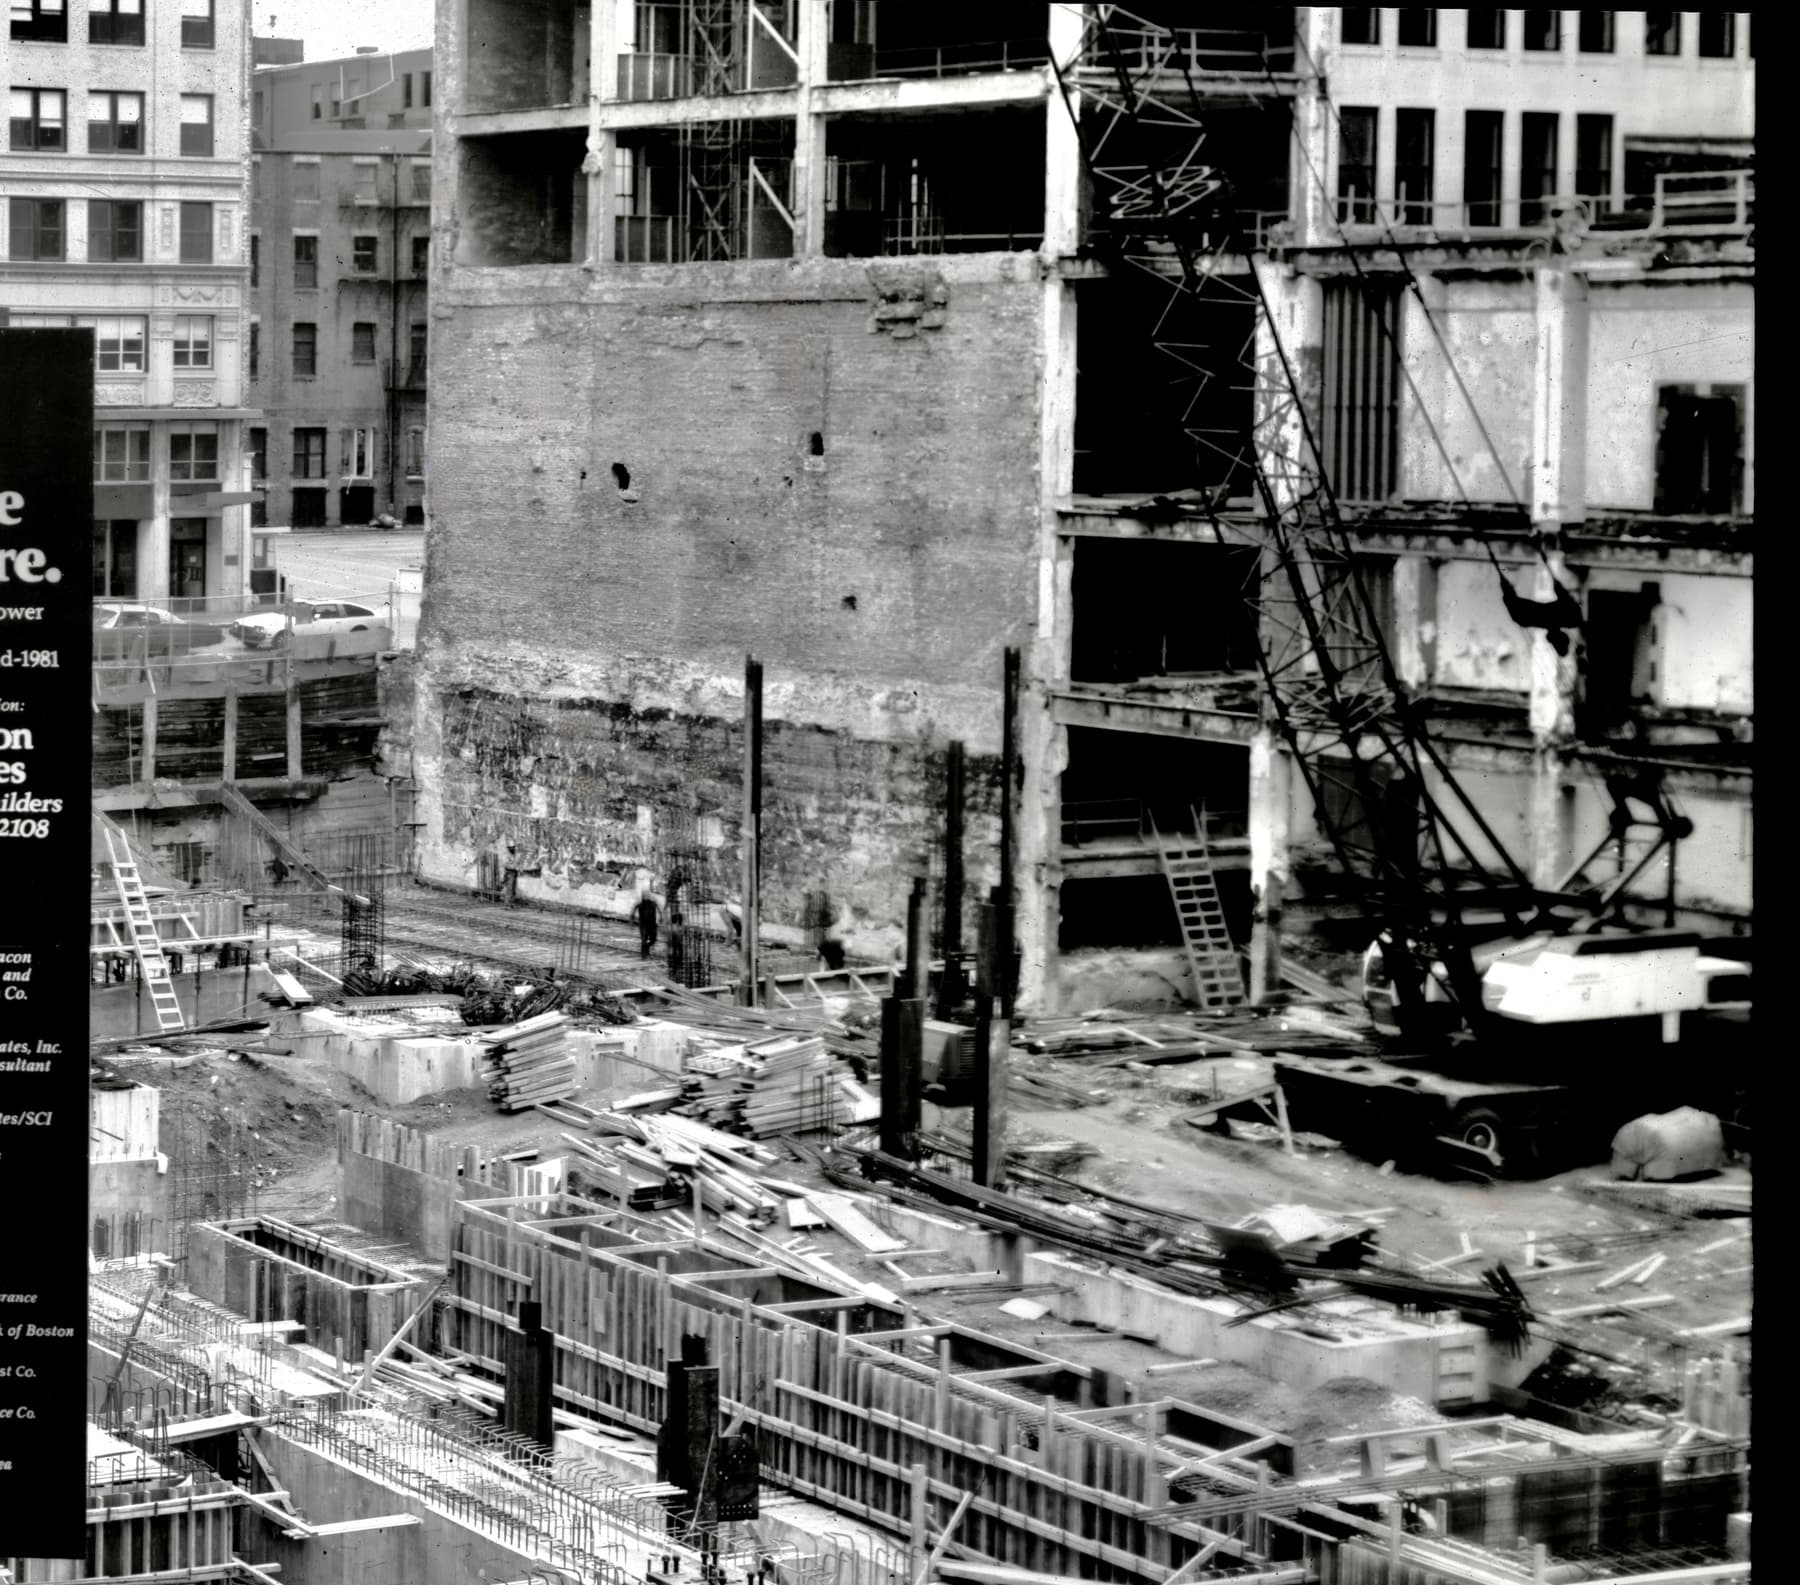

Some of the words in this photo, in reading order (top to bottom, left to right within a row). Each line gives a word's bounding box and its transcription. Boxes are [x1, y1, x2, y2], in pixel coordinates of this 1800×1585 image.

[2, 968, 32, 982] and
[5, 986, 28, 1000] Co.
[36, 1040, 62, 1054] Inc.
[7, 1324, 22, 1340] of
[26, 1325, 74, 1337] Boston
[15, 1366, 36, 1377] Co.
[16, 1407, 35, 1419] Co.
